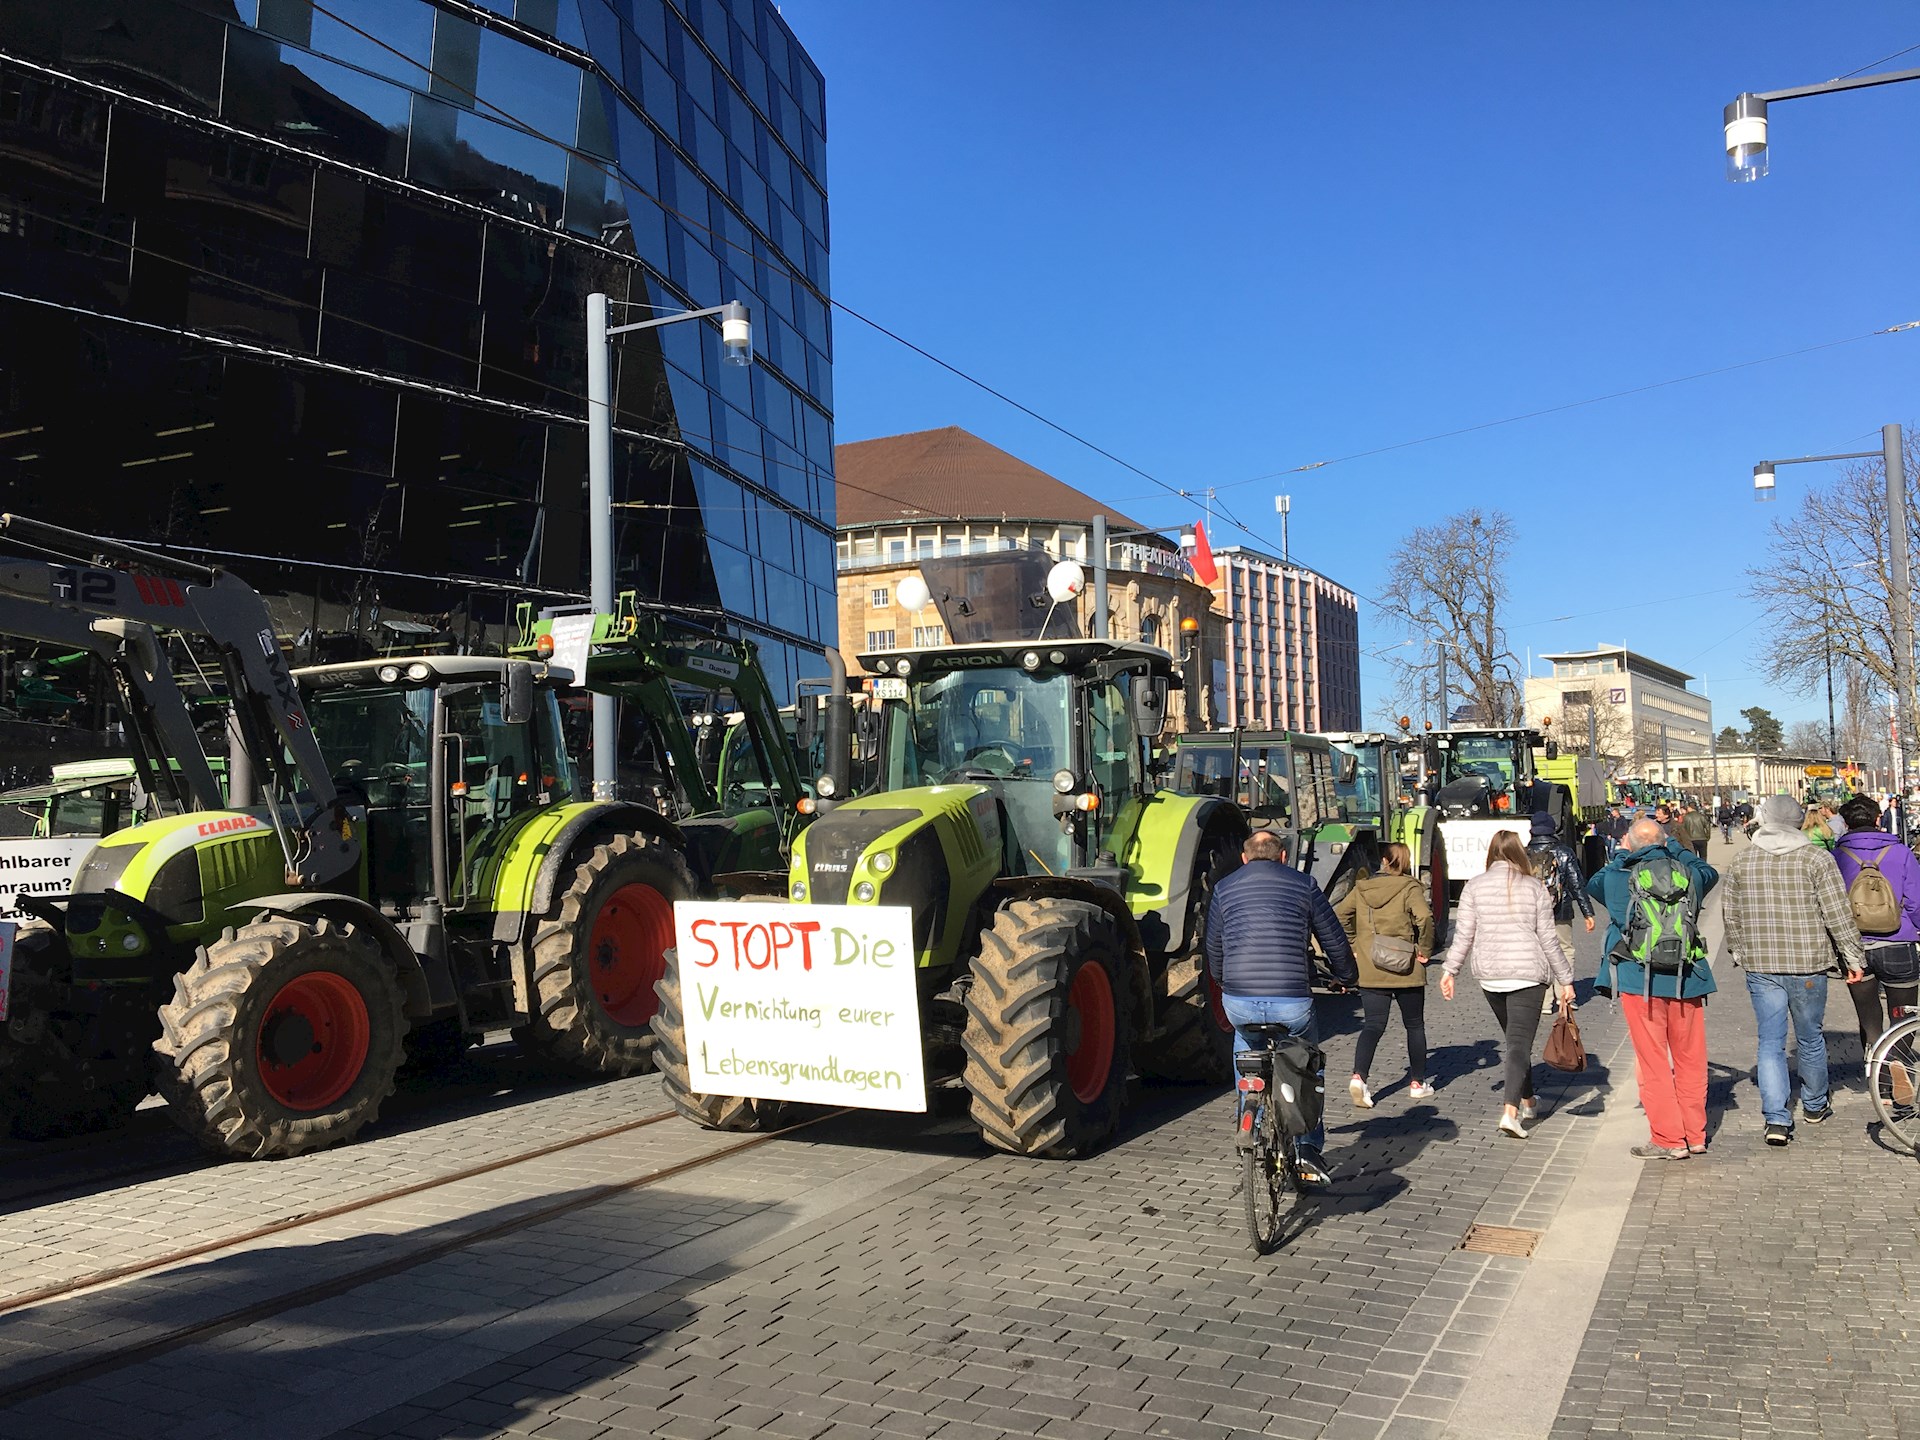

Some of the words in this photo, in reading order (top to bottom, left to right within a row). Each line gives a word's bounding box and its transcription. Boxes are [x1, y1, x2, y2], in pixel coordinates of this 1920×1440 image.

[1122, 541, 1175, 568] THEATER
[932, 655, 1003, 668] ARION
[318, 670, 363, 684] ARES
[882, 679, 893, 689] FR
[197, 815, 257, 837] CLAAS
[813, 862, 848, 873] CLAAS
[690, 918, 821, 972] STOPT
[830, 926, 895, 968] Die
[696, 982, 821, 1028] Vernichtung
[838, 1006, 895, 1026] eurer
[700, 1040, 902, 1090] Lebensgrundlagen
